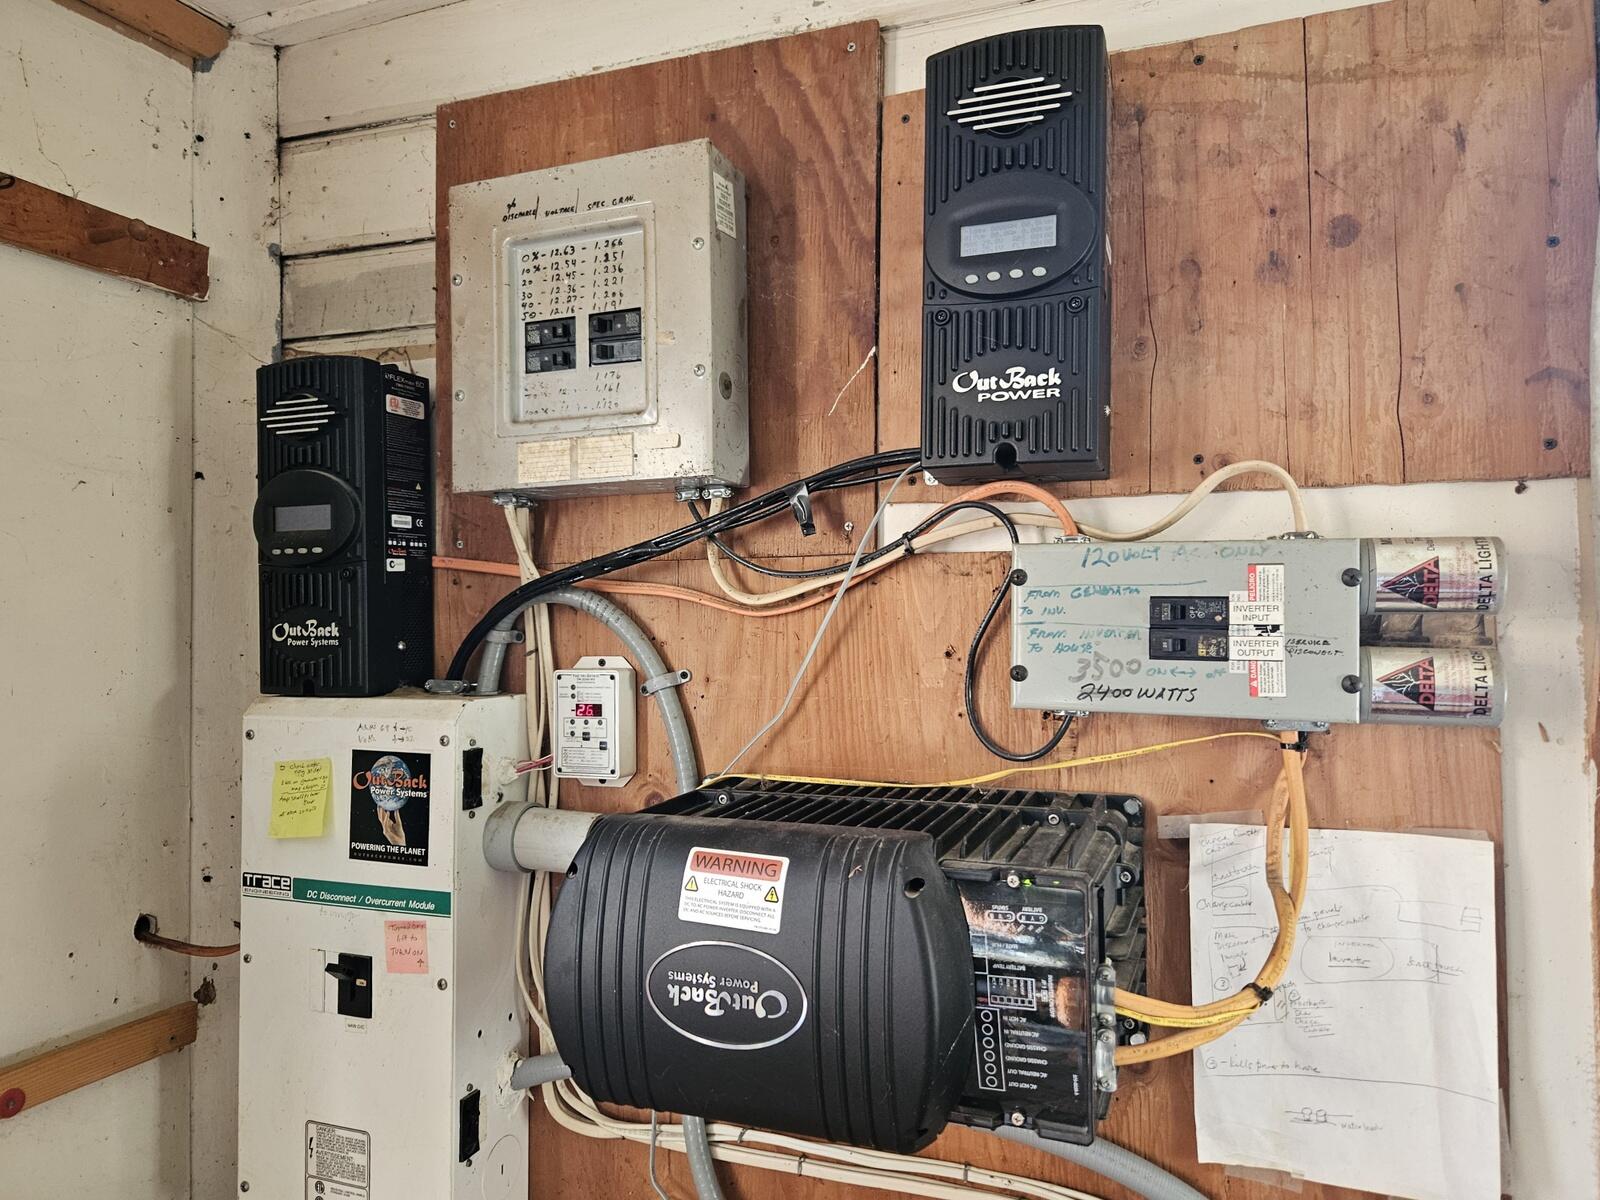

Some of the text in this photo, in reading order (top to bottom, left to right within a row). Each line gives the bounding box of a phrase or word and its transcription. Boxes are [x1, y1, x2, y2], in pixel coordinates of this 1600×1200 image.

[550, 245, 576, 258] 12.63
[594, 238, 624, 250] 1.266
[550, 259, 577, 271] 12.54
[593, 250, 624, 263] 1.251
[521, 265, 624, 287] 20 12.45 1.236
[521, 277, 624, 301] 30 12.36 1.221
[521, 302, 533, 310] 40
[521, 312, 536, 321] 50
[952, 366, 1062, 393] OutBack
[977, 388, 1061, 402] POWER
[1081, 547, 1119, 568] 120
[1422, 558, 1440, 605] DELTA
[1475, 574, 1493, 611] DELTA
[1232, 604, 1280, 613] INVERTER
[1242, 613, 1270, 622] INPUT
[272, 619, 339, 641] OutBack
[287, 637, 339, 648] Power Systems
[1232, 639, 1279, 648] INVERTER
[1237, 648, 1275, 657] OUTPUT
[1068, 652, 1142, 683] 3500
[1418, 659, 1435, 705] DELTA
[1076, 683, 1198, 702] 2400 WATTS
[1472, 675, 1489, 716] DELTA
[353, 768, 428, 790] OutBack
[370, 785, 428, 799] Power Systems
[351, 842, 426, 857] POWERING THE PLANET
[696, 854, 778, 878] WARNING
[703, 877, 762, 892] ELECTRICAL SHOCK
[306, 889, 318, 899] DC
[319, 890, 357, 904] Disconnect
[365, 896, 407, 909] Overcurrent
[408, 900, 436, 911] Module
[694, 896, 718, 906] ELECTRICAL
[717, 890, 745, 900] HAZARD
[724, 912, 739, 920] BEFORE
[739, 908, 767, 918] DISCONNECT
[991, 962, 1006, 970] TEMP
[668, 970, 759, 994] Power Systems
[667, 983, 788, 1019] OutBack
[1004, 1042, 1026, 1050] GROUND
[1005, 1055, 1027, 1063] GROUND
